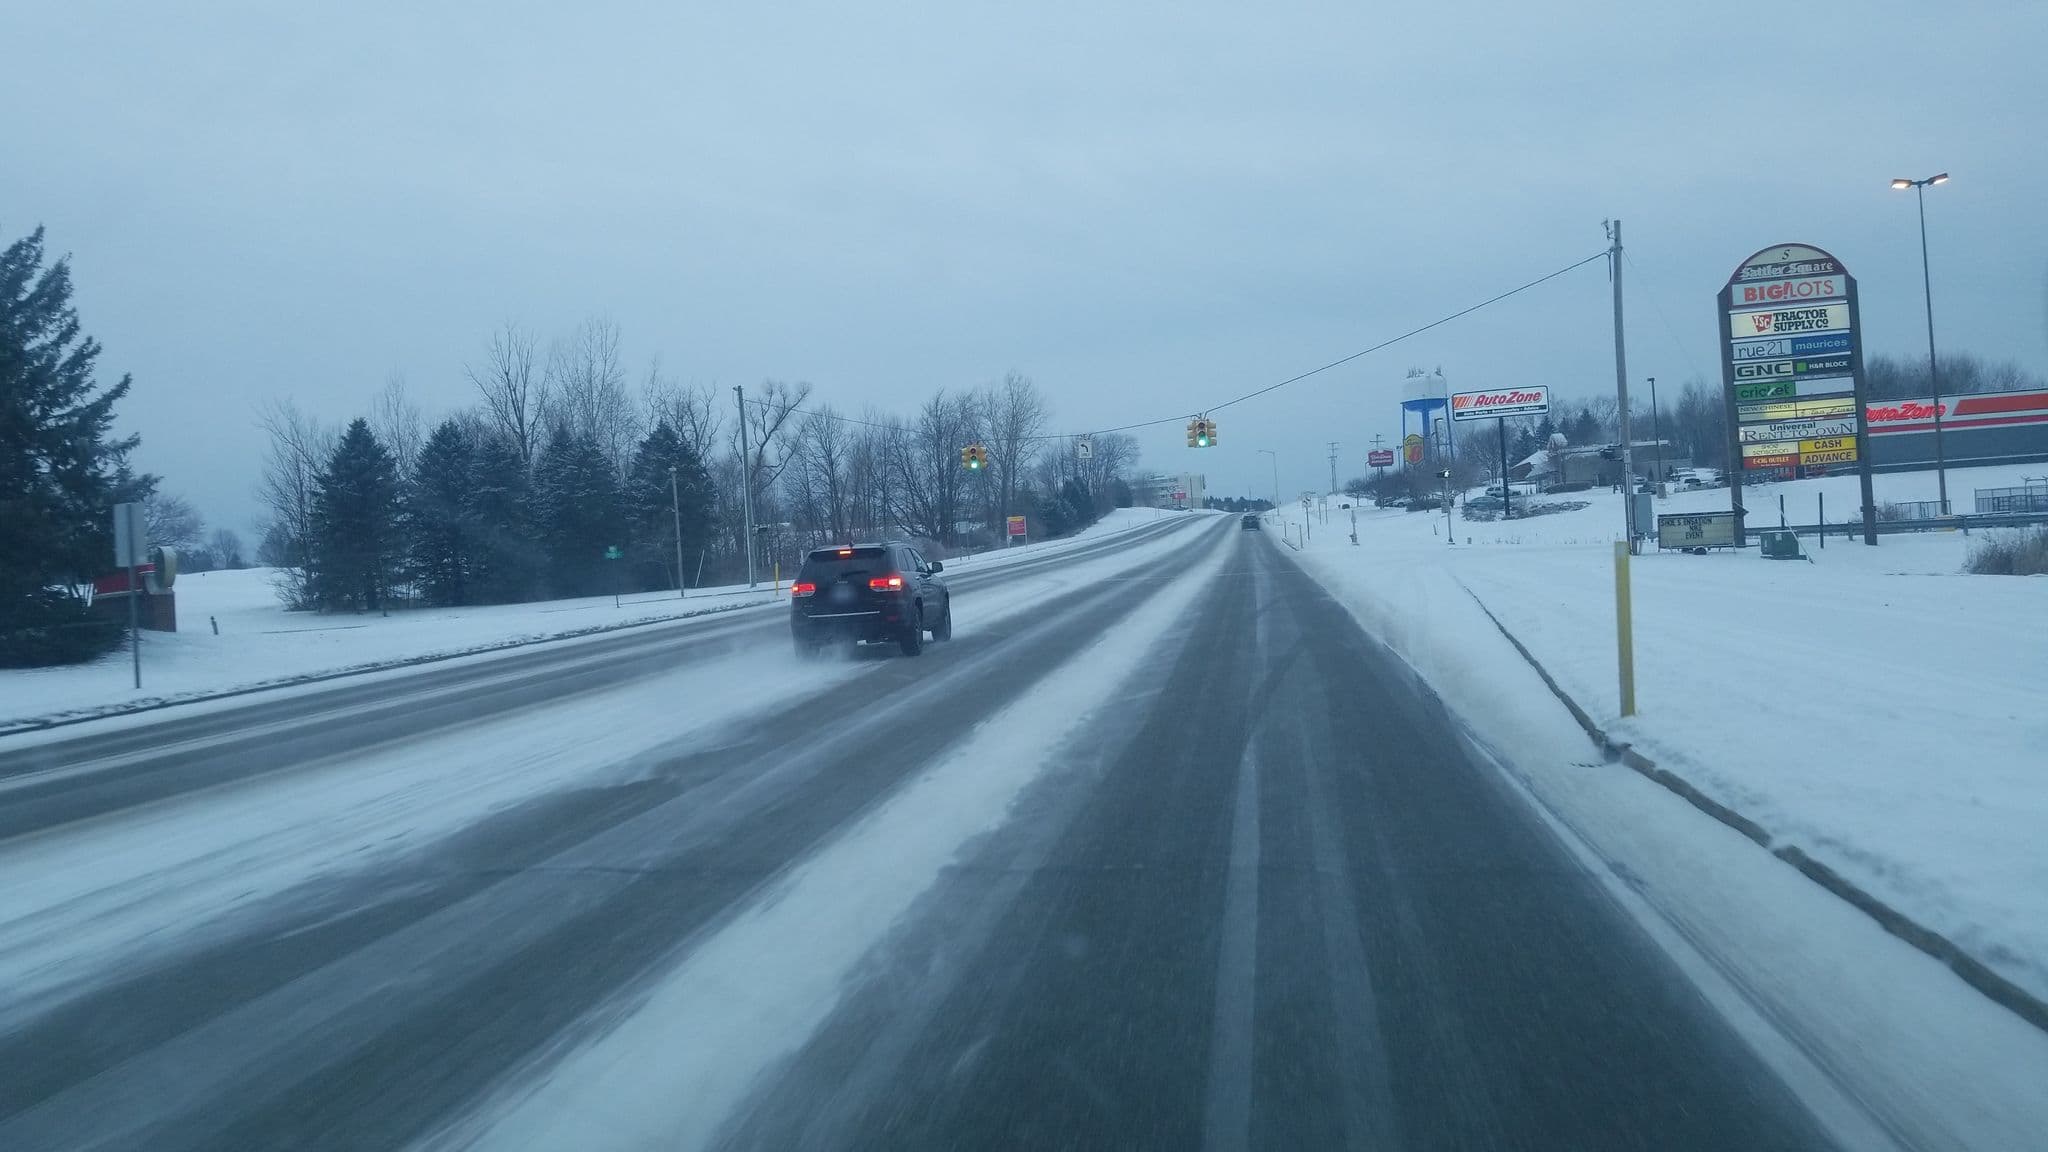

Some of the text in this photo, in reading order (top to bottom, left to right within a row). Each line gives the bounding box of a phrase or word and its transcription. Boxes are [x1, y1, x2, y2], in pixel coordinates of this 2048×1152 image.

[1789, 261, 1833, 275] Square
[1773, 309, 1827, 321] TRACTOR
[1774, 319, 1813, 332] SUPPLY
[1738, 341, 1785, 358] rue21
[1796, 339, 1847, 351] maurices
[1737, 363, 1791, 377] GNC
[1740, 384, 1790, 399] cricket
[1474, 391, 1542, 406] AutoZone
[1769, 422, 1816, 432] Universal
[1814, 440, 1842, 449] CASH
[1805, 452, 1851, 464] ADVANCE
[1686, 531, 1703, 539] EVENT
